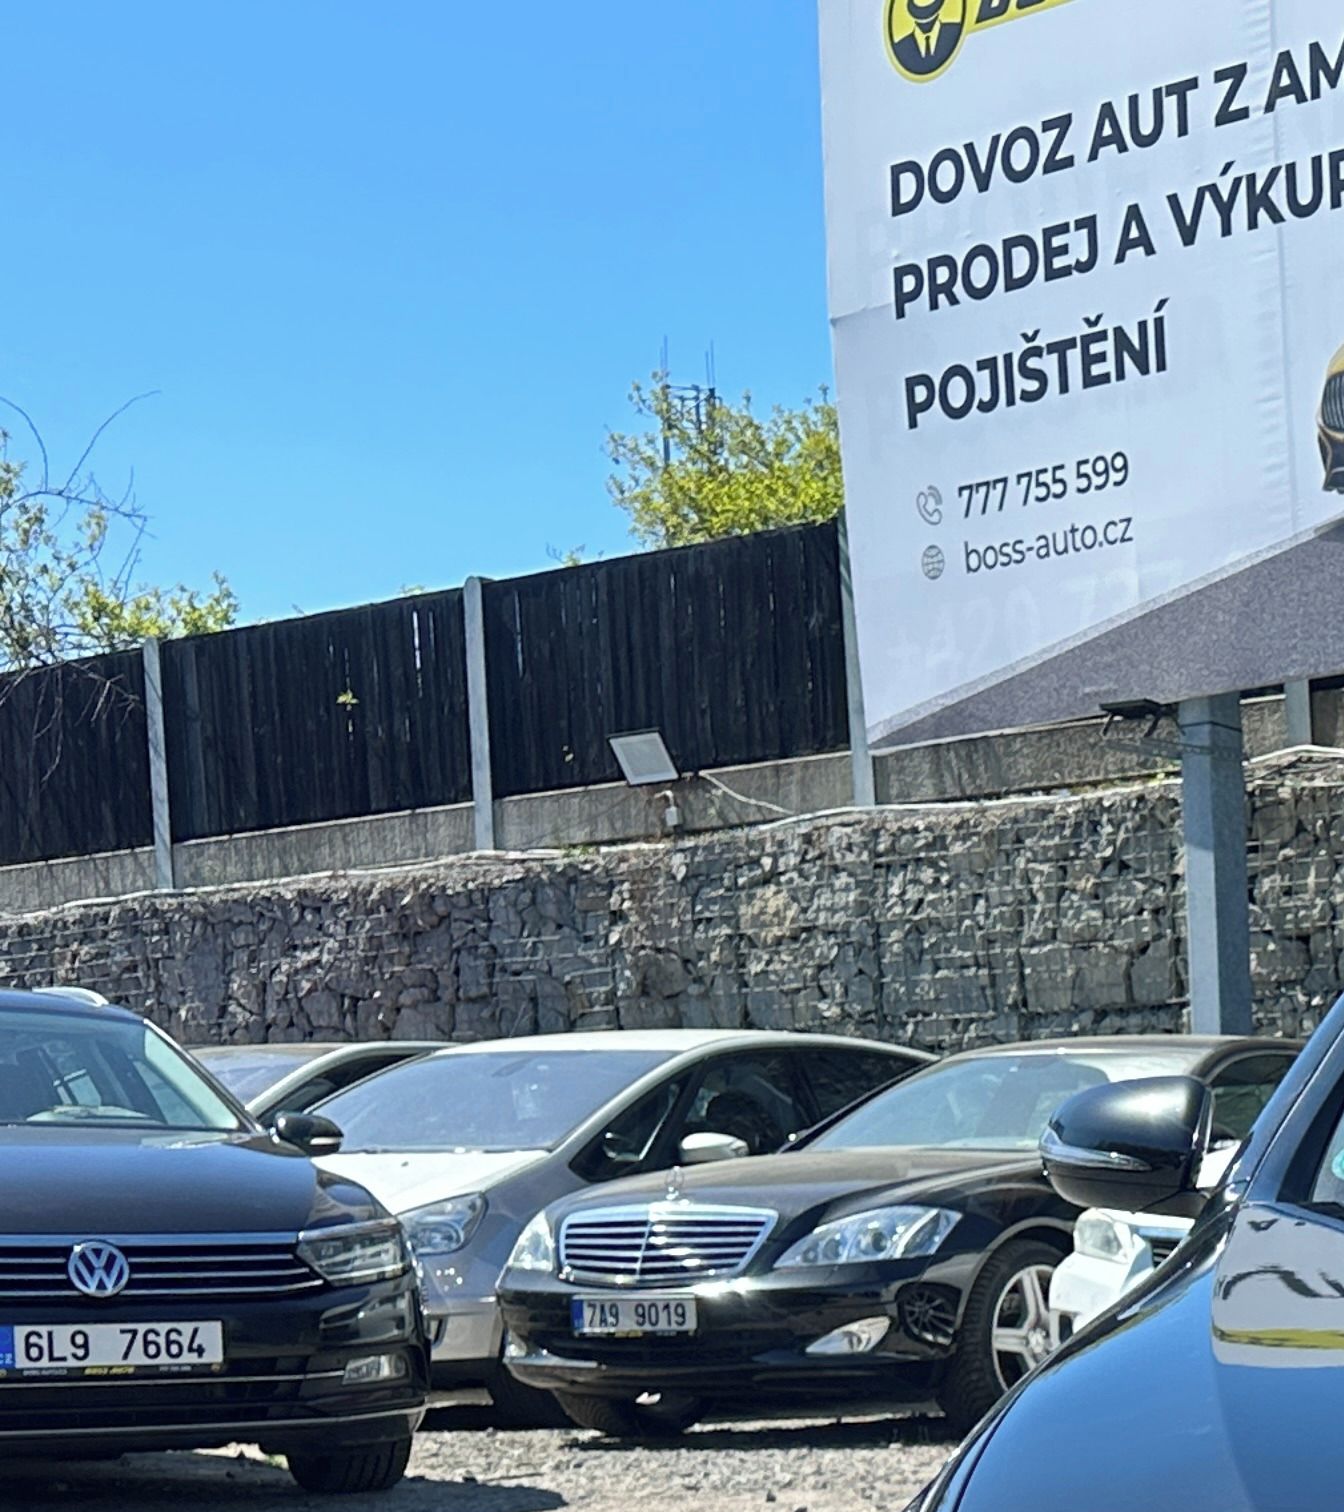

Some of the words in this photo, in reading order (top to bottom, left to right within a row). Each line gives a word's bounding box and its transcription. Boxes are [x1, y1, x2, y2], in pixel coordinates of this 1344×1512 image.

[890, 112, 1075, 217] DOVOZ
[1087, 76, 1199, 163] AUT
[1213, 62, 1250, 127] Z
[893, 214, 1098, 320] PRODEJ
[1114, 203, 1156, 264] A
[905, 297, 1170, 430] POJIŠTĚNÍ
[958, 476, 1008, 518] 777
[1016, 464, 1067, 506] 755
[1075, 451, 1129, 494] 599
[964, 517, 1134, 574] boss-auto.cz
[24, 1329, 90, 1362] 6L9
[119, 1327, 206, 1361] 7664
[587, 1303, 619, 1327] 7A9
[634, 1302, 687, 1327] 9019
